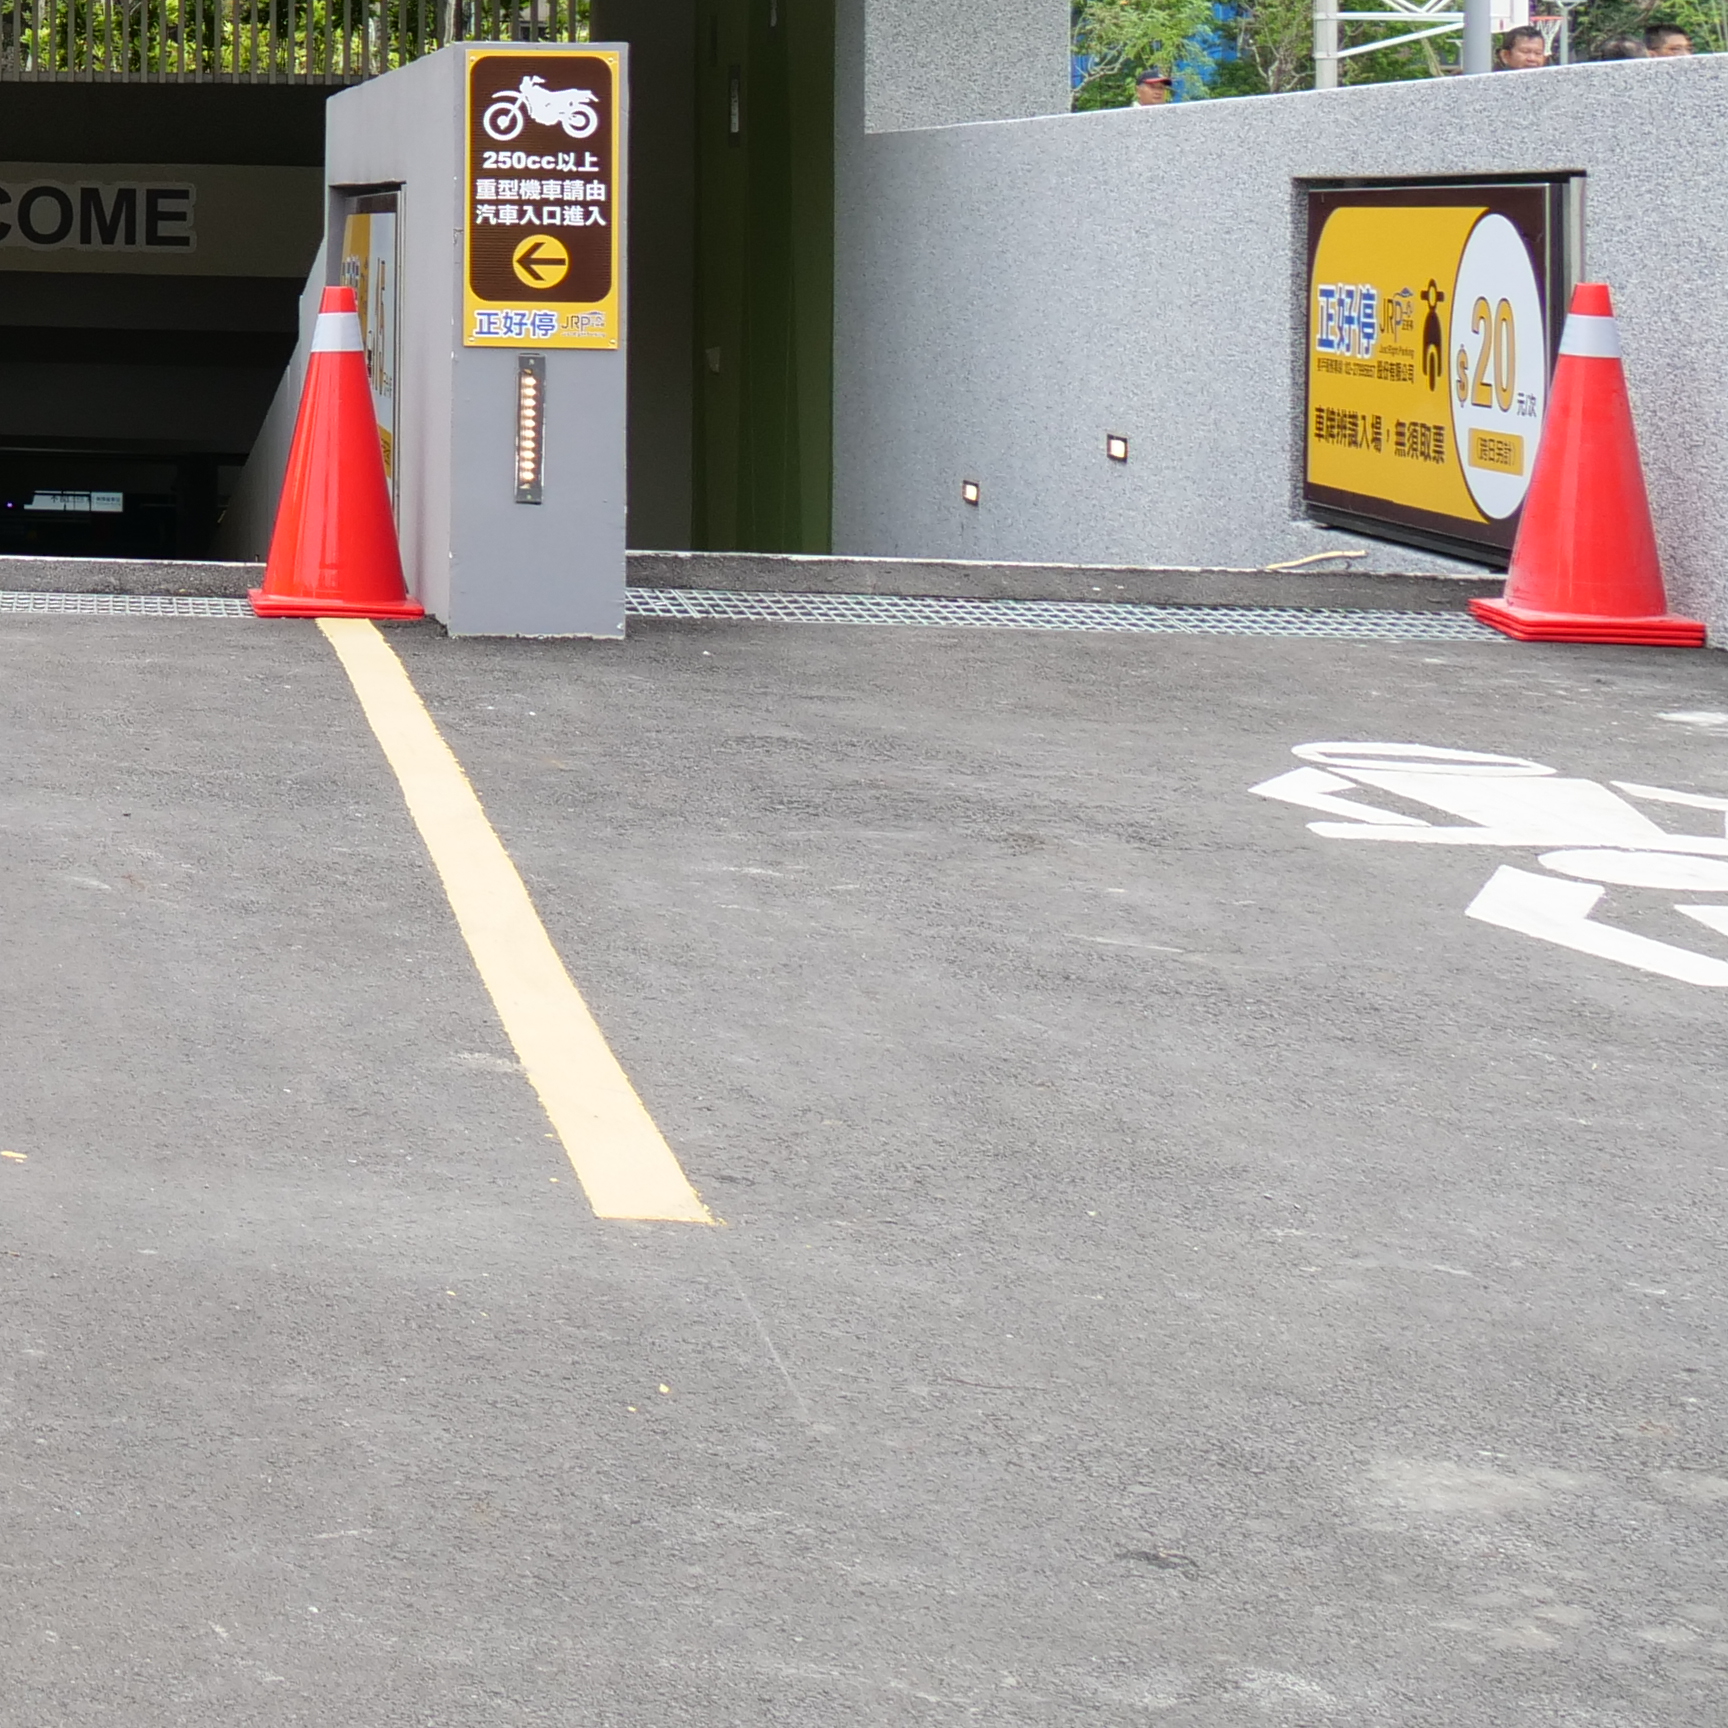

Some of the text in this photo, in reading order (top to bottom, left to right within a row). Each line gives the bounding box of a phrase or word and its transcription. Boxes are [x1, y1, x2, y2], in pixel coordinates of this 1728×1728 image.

[482, 151, 600, 172] 250cc以上
[476, 178, 606, 201] 重型機車請由
[475, 203, 607, 226] 汽車入口進入
[474, 311, 556, 337] 正好停
[1317, 285, 1377, 359] 正好停
